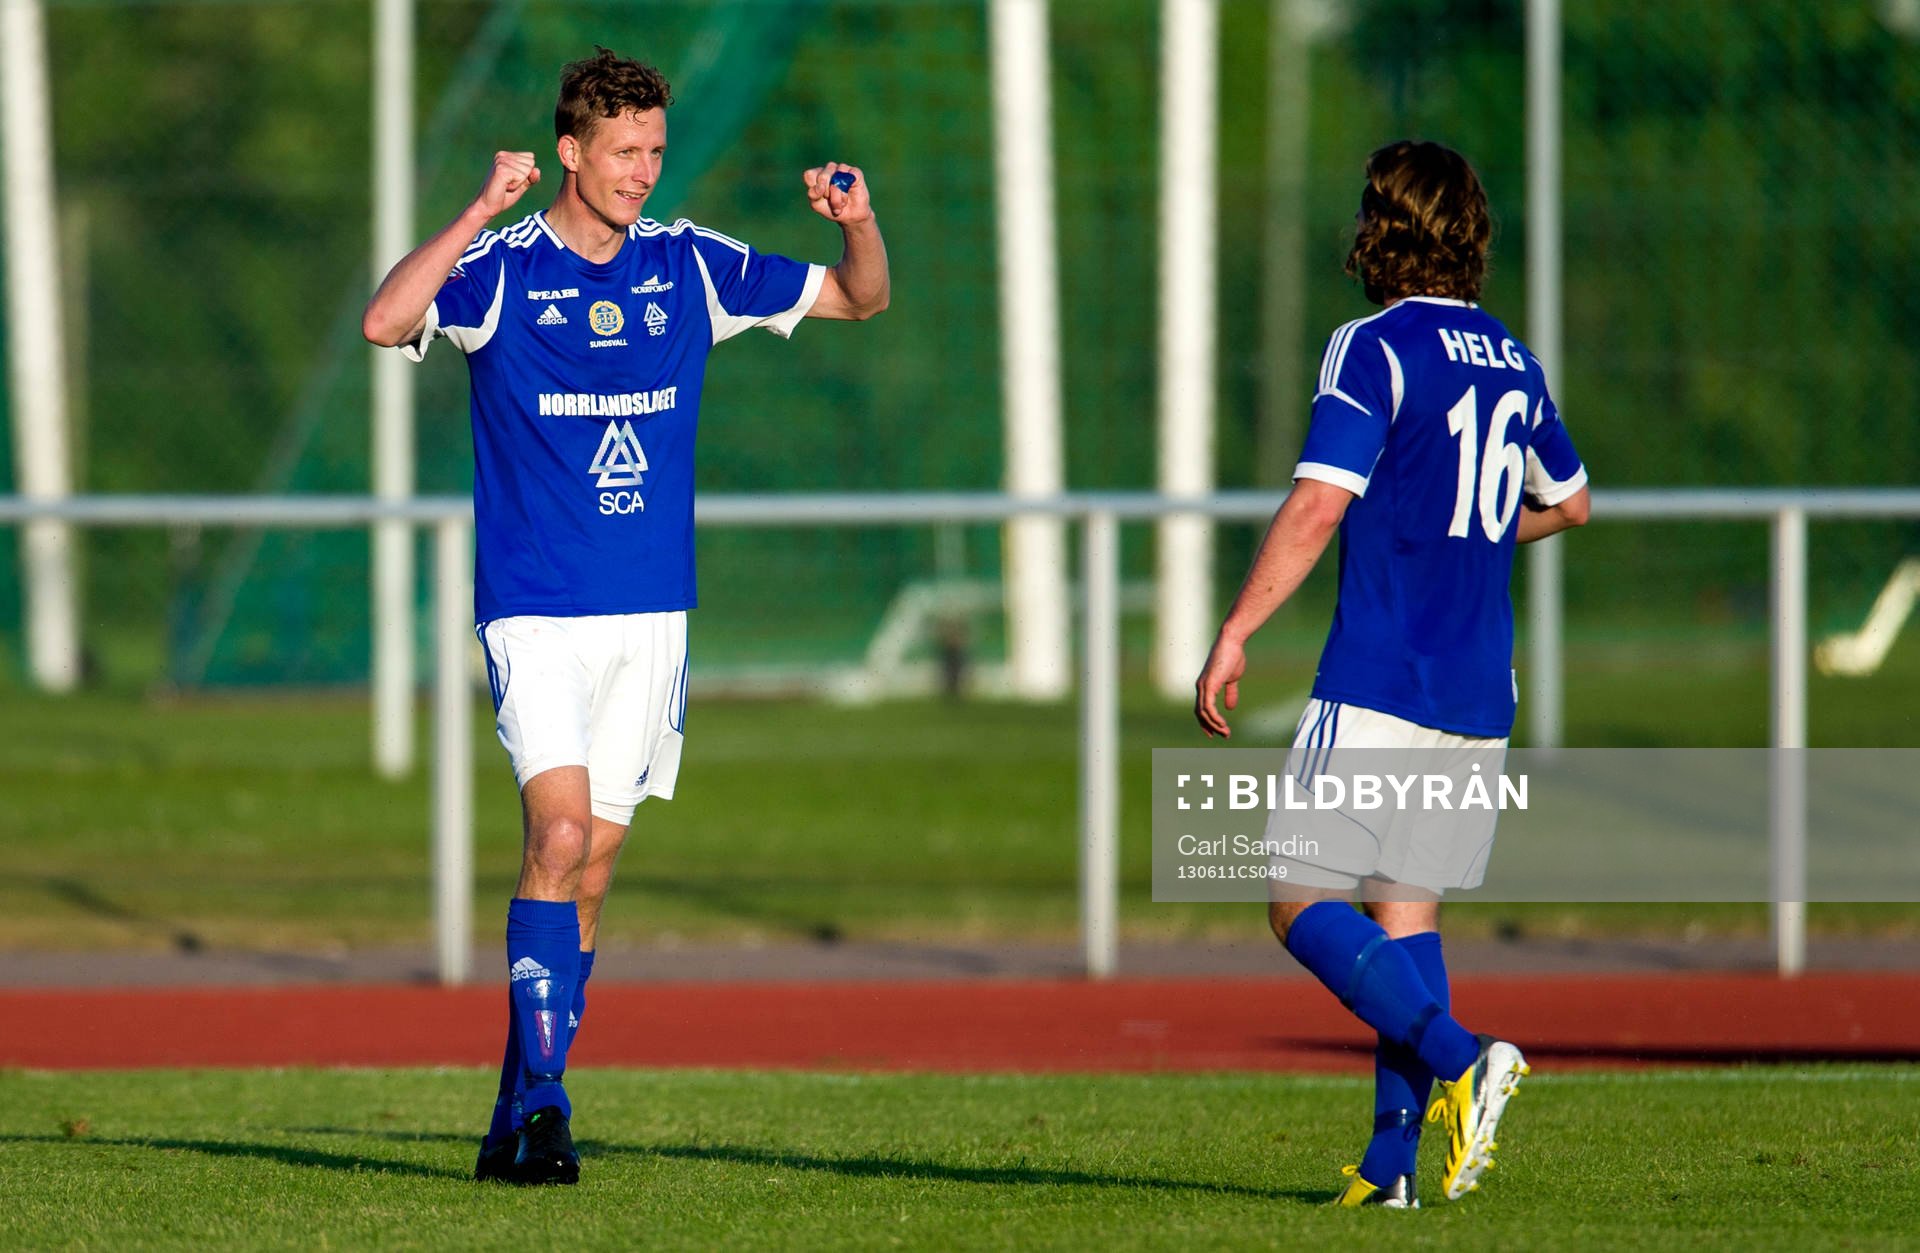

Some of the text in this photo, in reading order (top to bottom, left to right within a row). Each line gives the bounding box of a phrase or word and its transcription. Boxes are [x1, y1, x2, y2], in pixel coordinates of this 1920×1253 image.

[537, 317, 568, 325] adidas
[648, 326, 665, 336] SCA
[589, 338, 628, 348] SUNDSVALL
[1438, 328, 1526, 372] HELG
[1447, 384, 1529, 544] 16
[599, 490, 644, 515] SCA
[511, 968, 551, 983] didas
